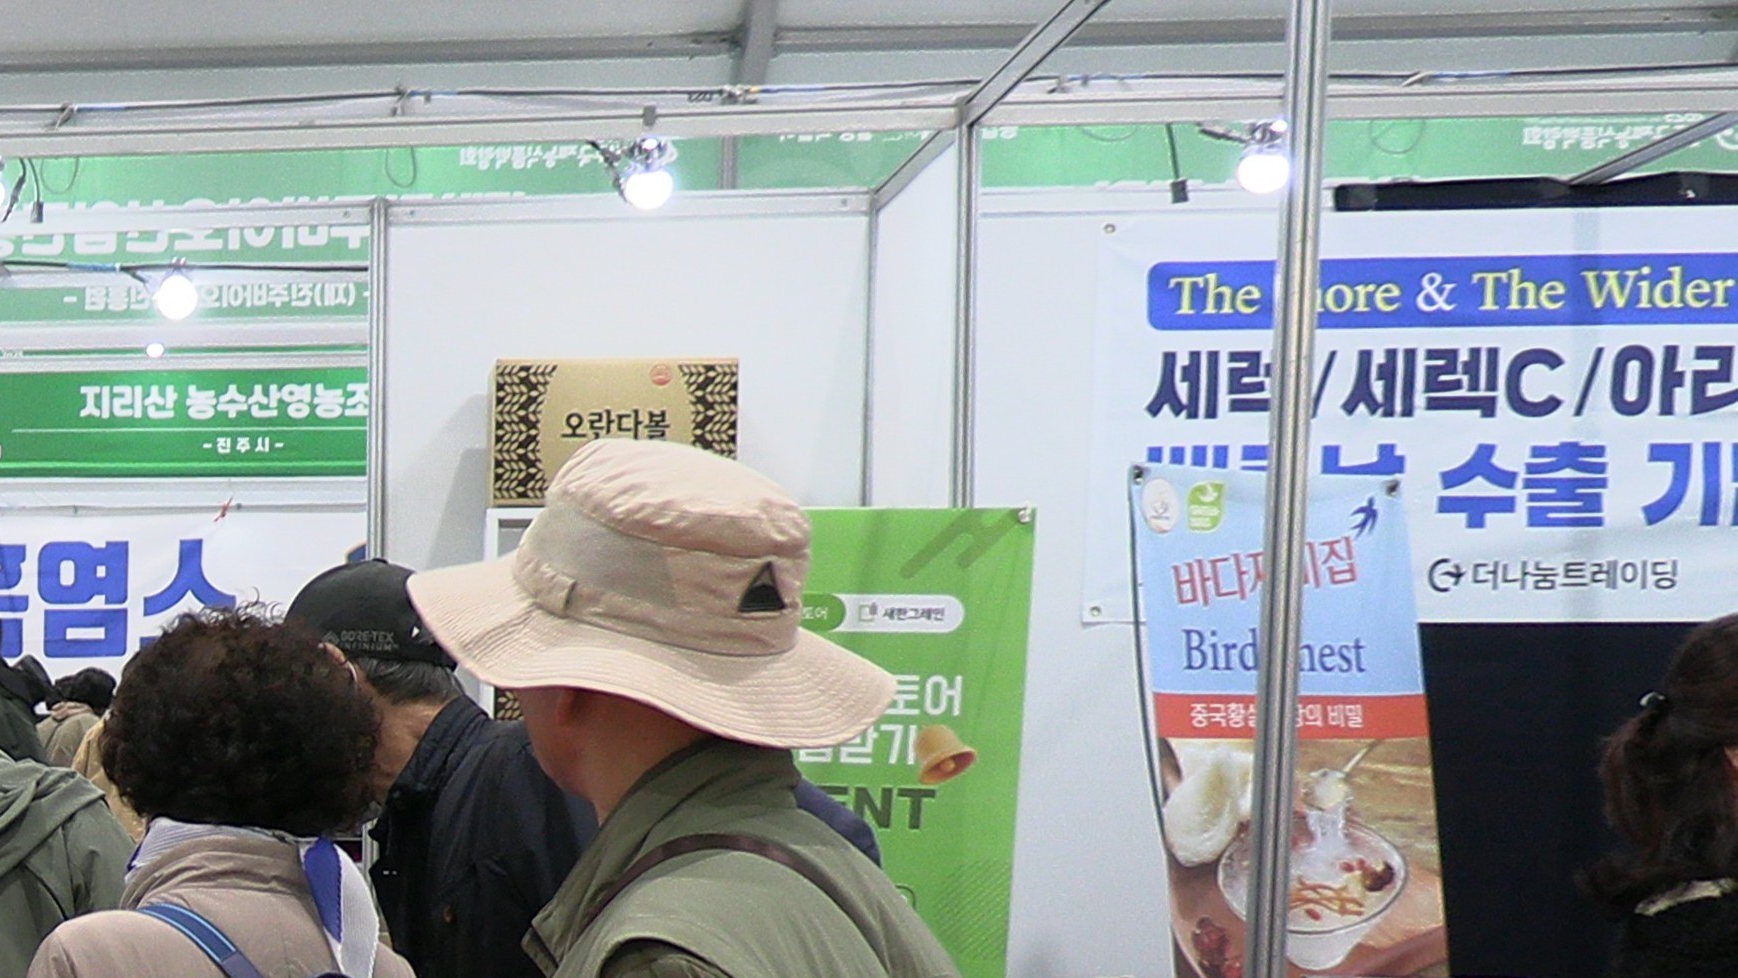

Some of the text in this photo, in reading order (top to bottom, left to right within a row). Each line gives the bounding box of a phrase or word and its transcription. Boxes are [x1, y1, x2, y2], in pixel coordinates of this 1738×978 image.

[1168, 275, 1261, 317] The
[1415, 271, 1457, 313] &
[1472, 270, 1567, 312] The
[1580, 265, 1736, 310] Wider
[79, 381, 369, 421] 지리산 농수산영농조
[560, 408, 671, 440] 오란다볼
[1436, 441, 1738, 529] 수출 기
[1472, 558, 1680, 593] 더나눔트레이딩
[882, 605, 945, 621] 새한그레인
[340, 630, 395, 642] GORE-TEX
[1327, 703, 1365, 729] 비밀
